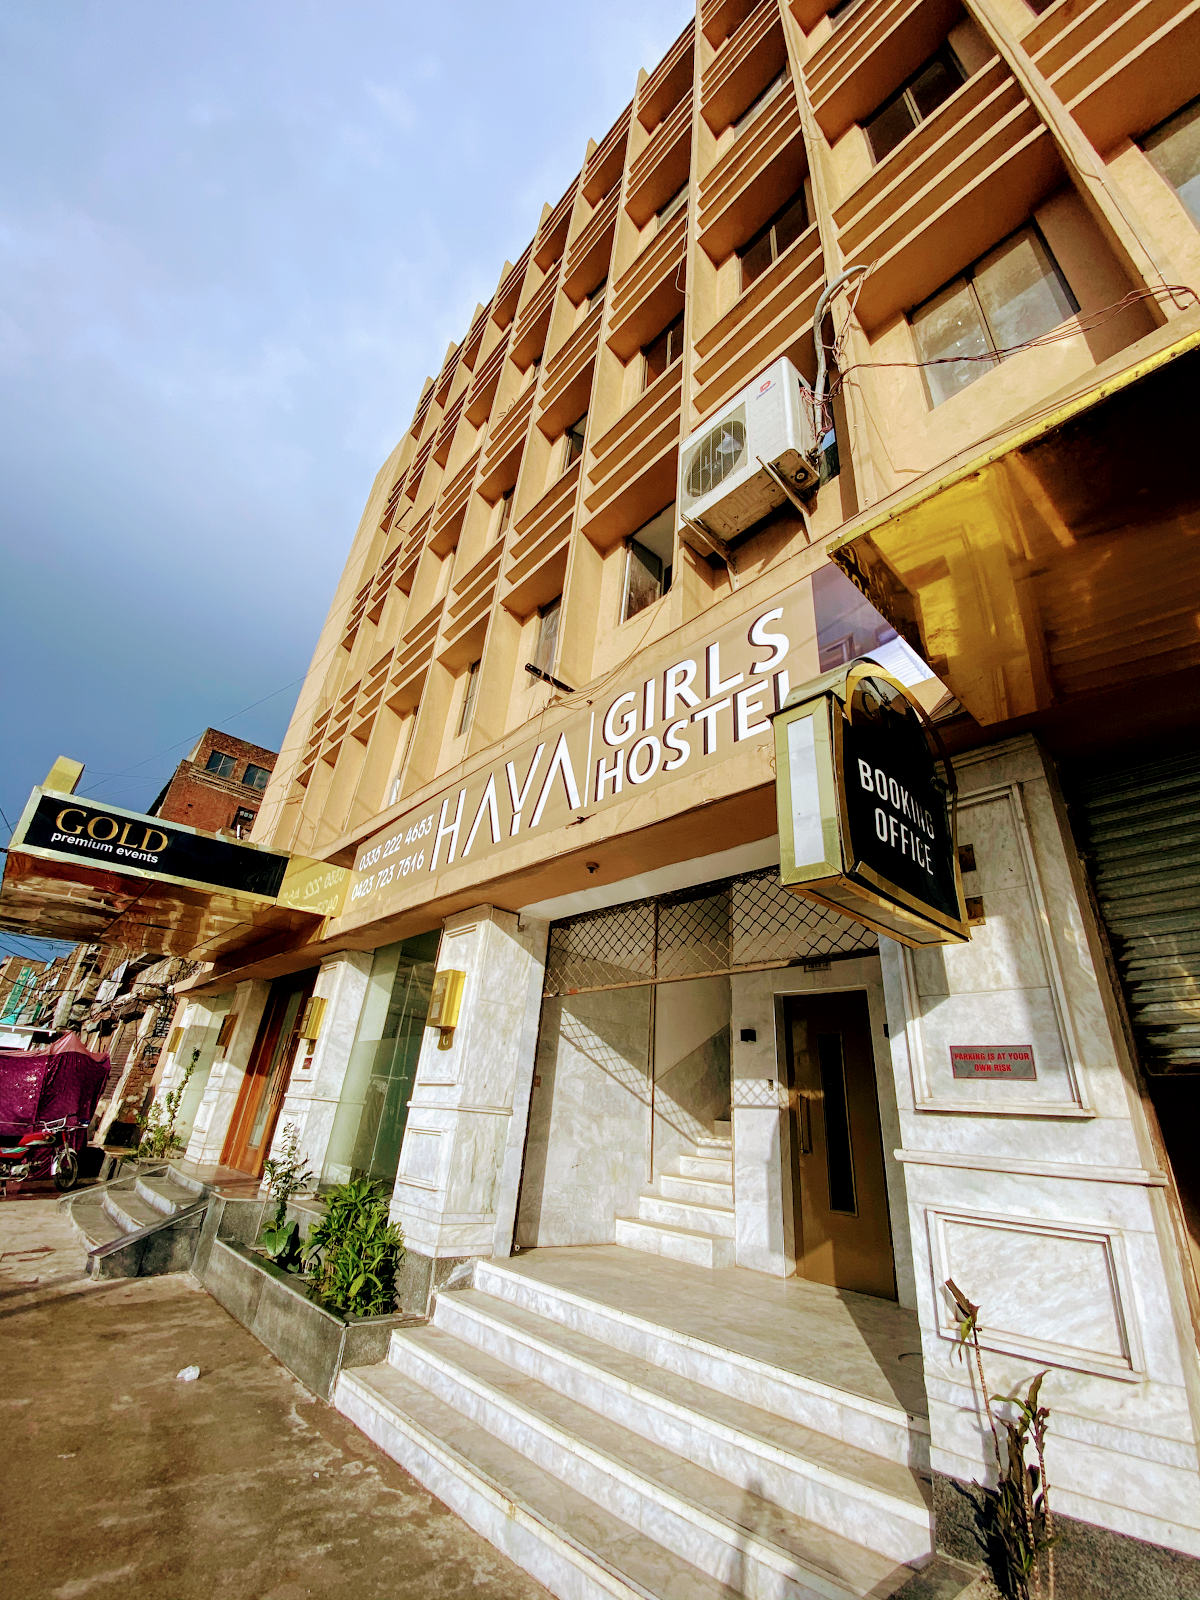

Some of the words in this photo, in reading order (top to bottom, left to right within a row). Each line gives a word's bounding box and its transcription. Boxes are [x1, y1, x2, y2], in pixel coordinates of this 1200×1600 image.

[602, 607, 790, 746] GIRLS
[429, 732, 581, 872] HAYA
[858, 758, 934, 840] BOOKING
[50, 832, 113, 853] premium
[116, 846, 158, 863] events
[56, 808, 168, 853] GOLD
[358, 844, 382, 872] 0335
[382, 832, 403, 859] 222
[404, 813, 434, 845] 4653
[875, 807, 933, 876] OFFICE
[351, 874, 375, 902] 0423
[375, 863, 396, 890] 723
[396, 848, 424, 880] 7516
[954, 1052, 986, 1061] PARKING
[988, 1052, 995, 1061] IS
[997, 1052, 1006, 1061] AT
[1008, 1052, 1030, 1061] YOUR
[974, 1063, 992, 1072] OWN
[994, 1063, 1012, 1072] RISK
